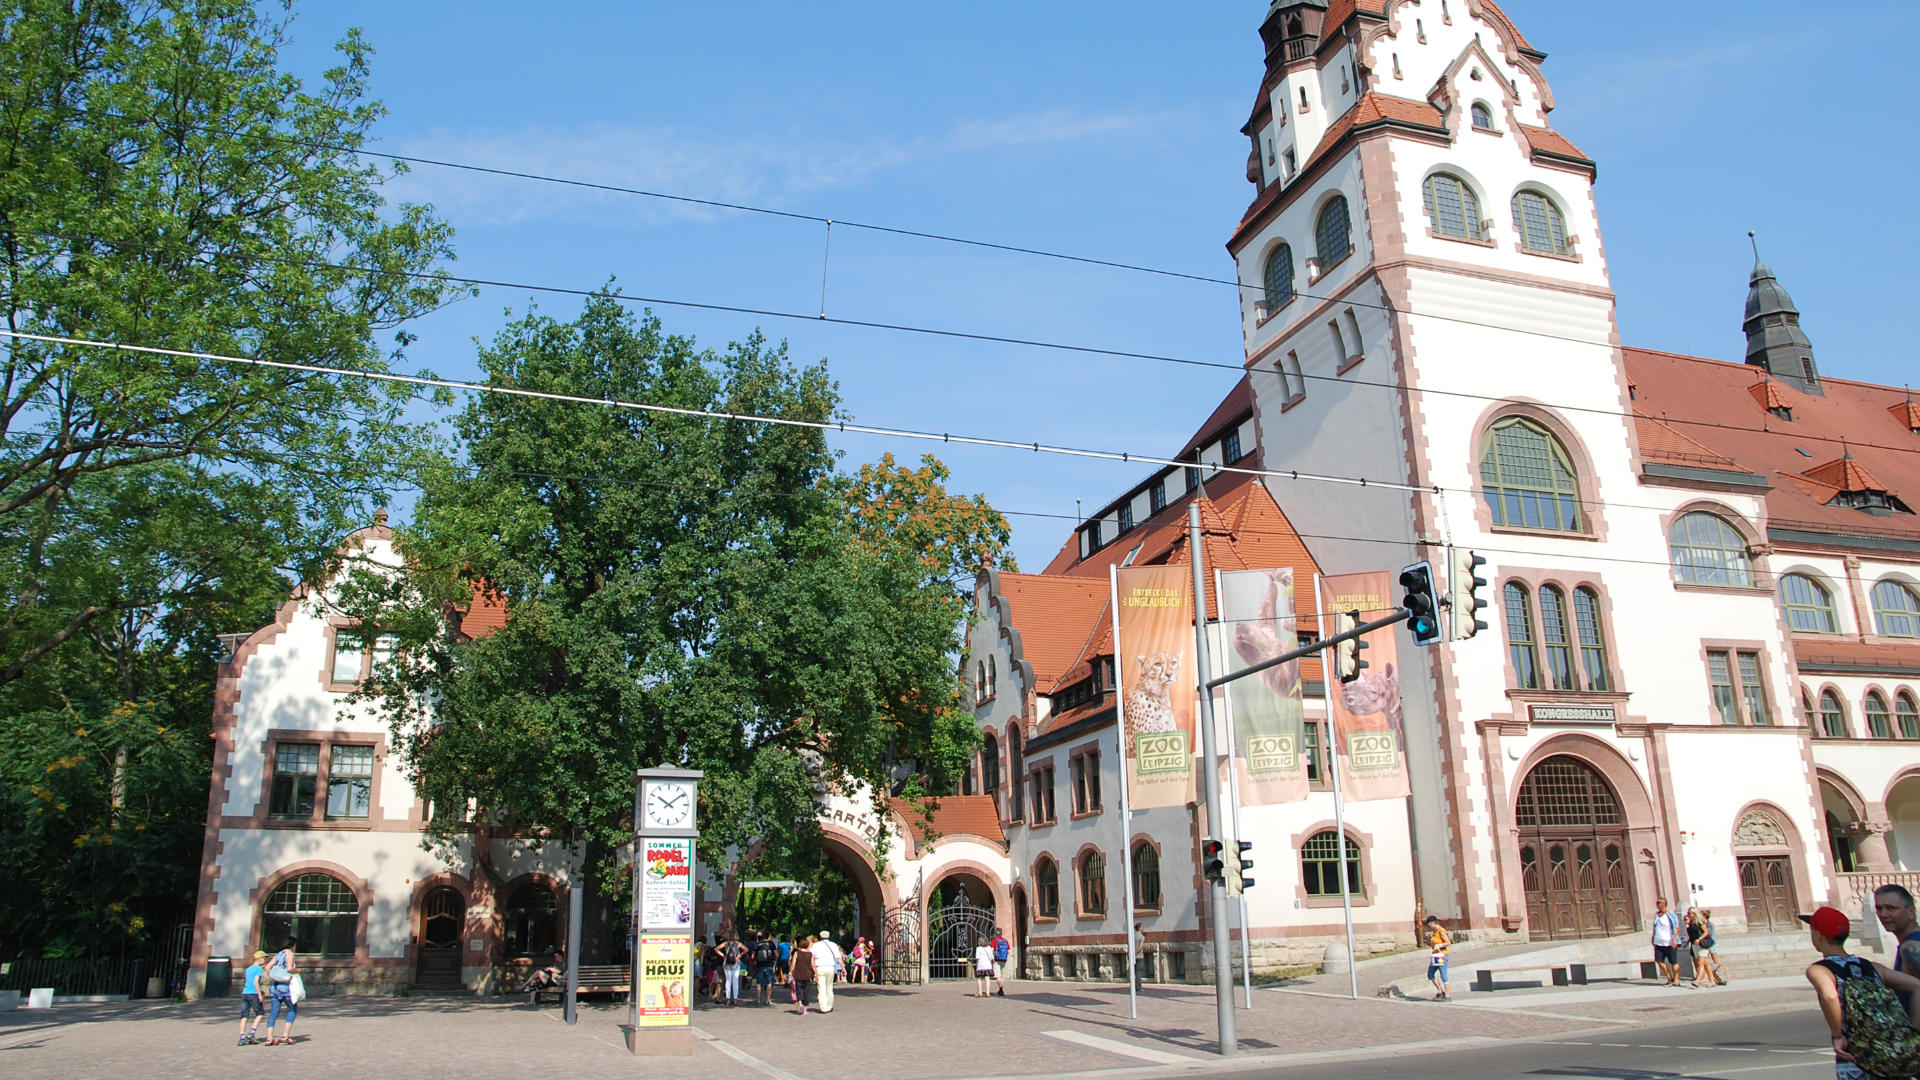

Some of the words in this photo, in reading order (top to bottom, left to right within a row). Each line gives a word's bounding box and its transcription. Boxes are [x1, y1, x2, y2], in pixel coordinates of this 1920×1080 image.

[1132, 587, 1164, 597] ENTDECKE
[1165, 588, 1178, 596] DAS
[1336, 594, 1366, 603] ENTDECKE
[1367, 594, 1380, 602] DAS
[1533, 708, 1615, 720] KONGRESSHALLE
[1142, 737, 1182, 754] ZOO
[1251, 738, 1291, 754] ZOO
[1353, 736, 1391, 752] ZOO
[1143, 756, 1182, 768] LEIPZIG
[1253, 756, 1292, 768] LEIPZIG
[1355, 754, 1392, 766] LEIPZIG
[822, 807, 880, 840] GARTE
[646, 965, 685, 975] HAUS
